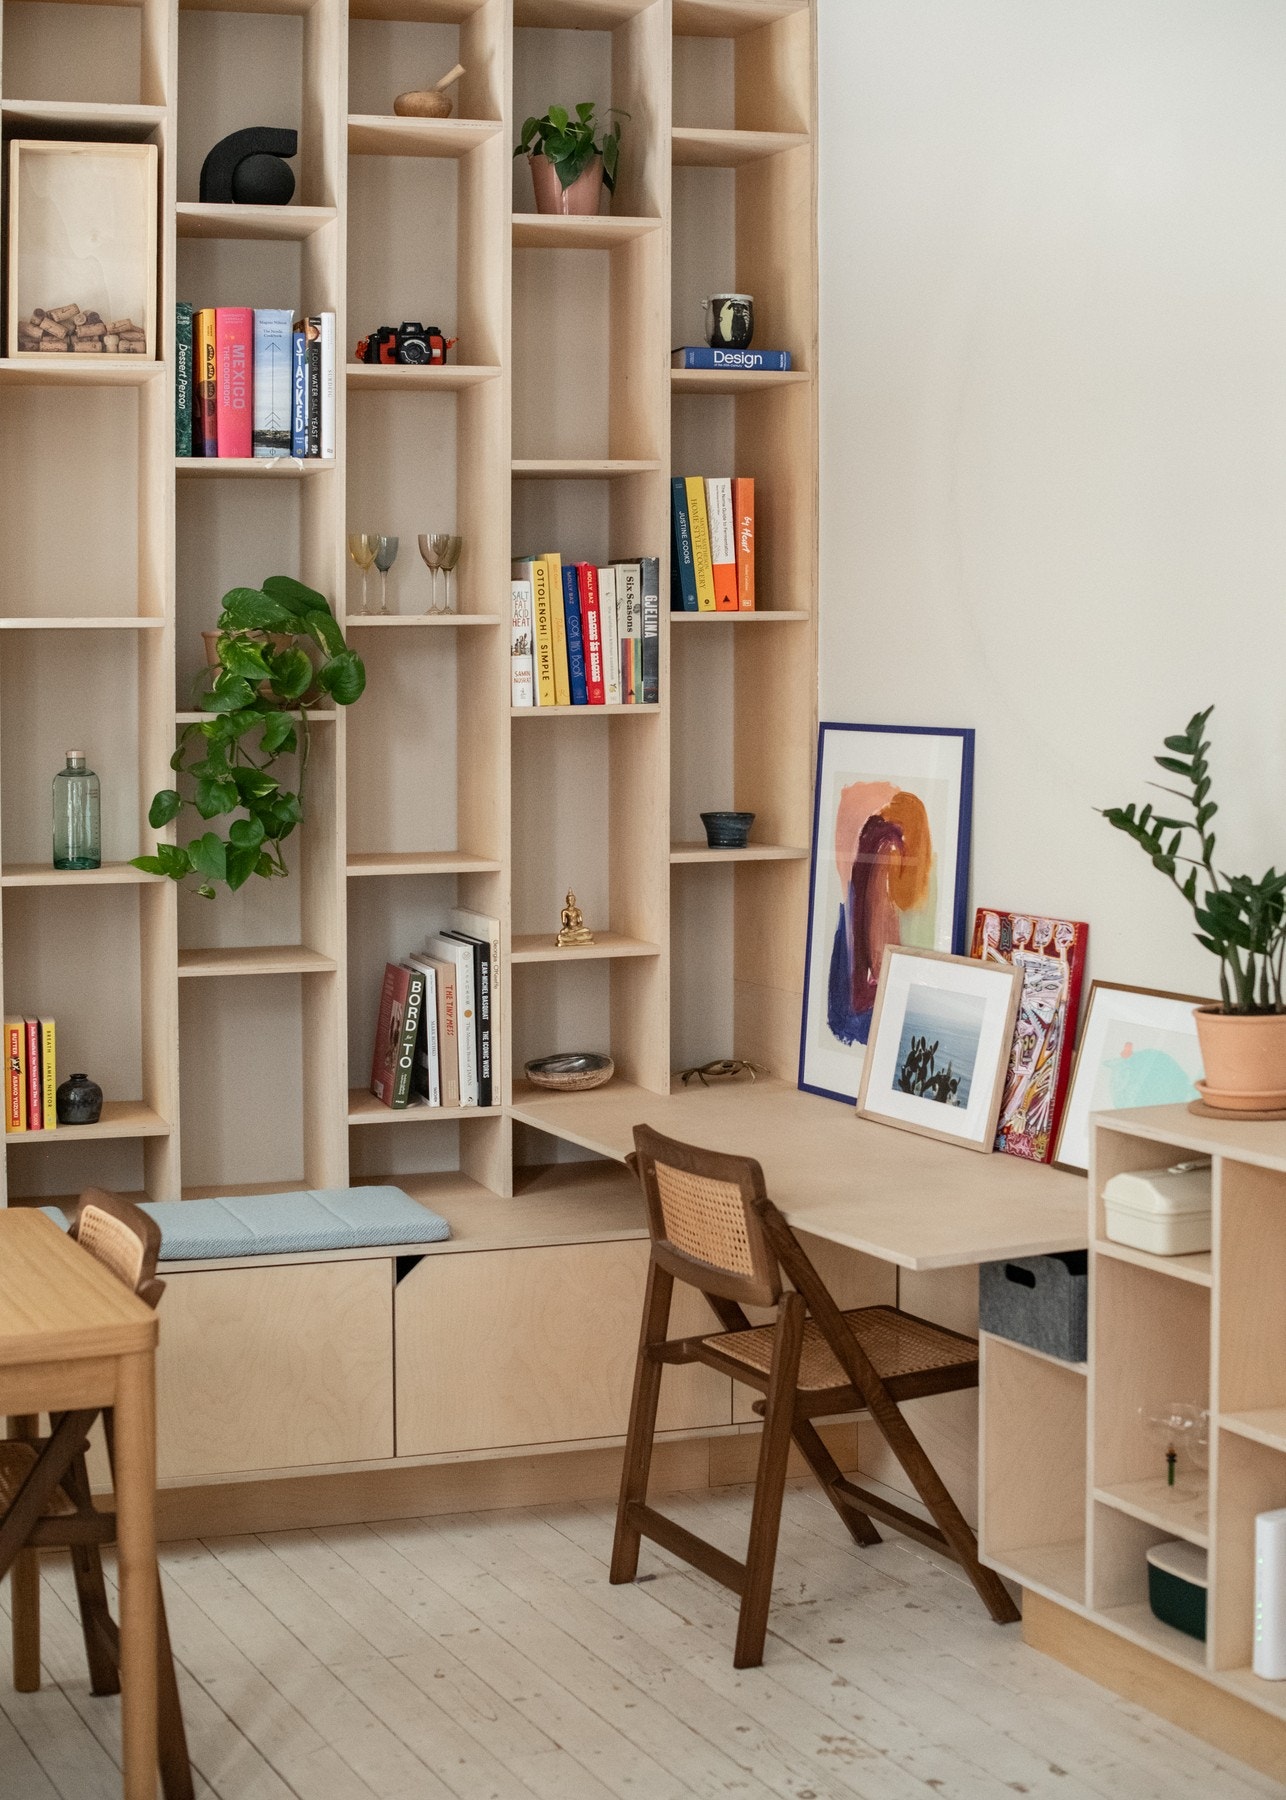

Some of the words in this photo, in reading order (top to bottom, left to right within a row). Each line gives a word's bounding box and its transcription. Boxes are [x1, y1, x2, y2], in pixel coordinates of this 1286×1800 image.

[178, 343, 188, 378] Dessert
[714, 351, 763, 369] Design
[223, 362, 231, 407] COOKBOOK
[232, 344, 246, 409] MEXICO
[295, 338, 304, 433] STACKED
[178, 379, 188, 410] Person
[690, 498, 699, 523] HOME
[741, 516, 752, 526] by
[679, 511, 688, 539] JUSTINE
[693, 525, 702, 550] STYLE
[682, 540, 691, 564] COOKS
[741, 528, 753, 553] Heart
[696, 551, 707, 590] COOKERY
[512, 591, 529, 601] SALT
[625, 576, 635, 592] Six
[514, 600, 527, 609] FAT
[514, 608, 529, 618] ACID
[536, 568, 547, 635] OTTOLENGHI
[626, 593, 635, 633] Seasons
[512, 618, 530, 627] HEAT
[568, 615, 580, 638] COOK
[644, 595, 658, 638] GJELINA
[540, 644, 550, 681] SIMPLE
[481, 961, 489, 995] JEAN-MICHEL
[445, 985, 454, 1000] THE
[405, 980, 422, 1032] BORD
[446, 1002, 454, 1018] TINY
[481, 995, 489, 1020] BASQUIAT
[446, 1018, 454, 1036] MESS
[399, 1043, 414, 1068] TO
[482, 1042, 490, 1059] ICONIC
[482, 1060, 490, 1078] WORKS
